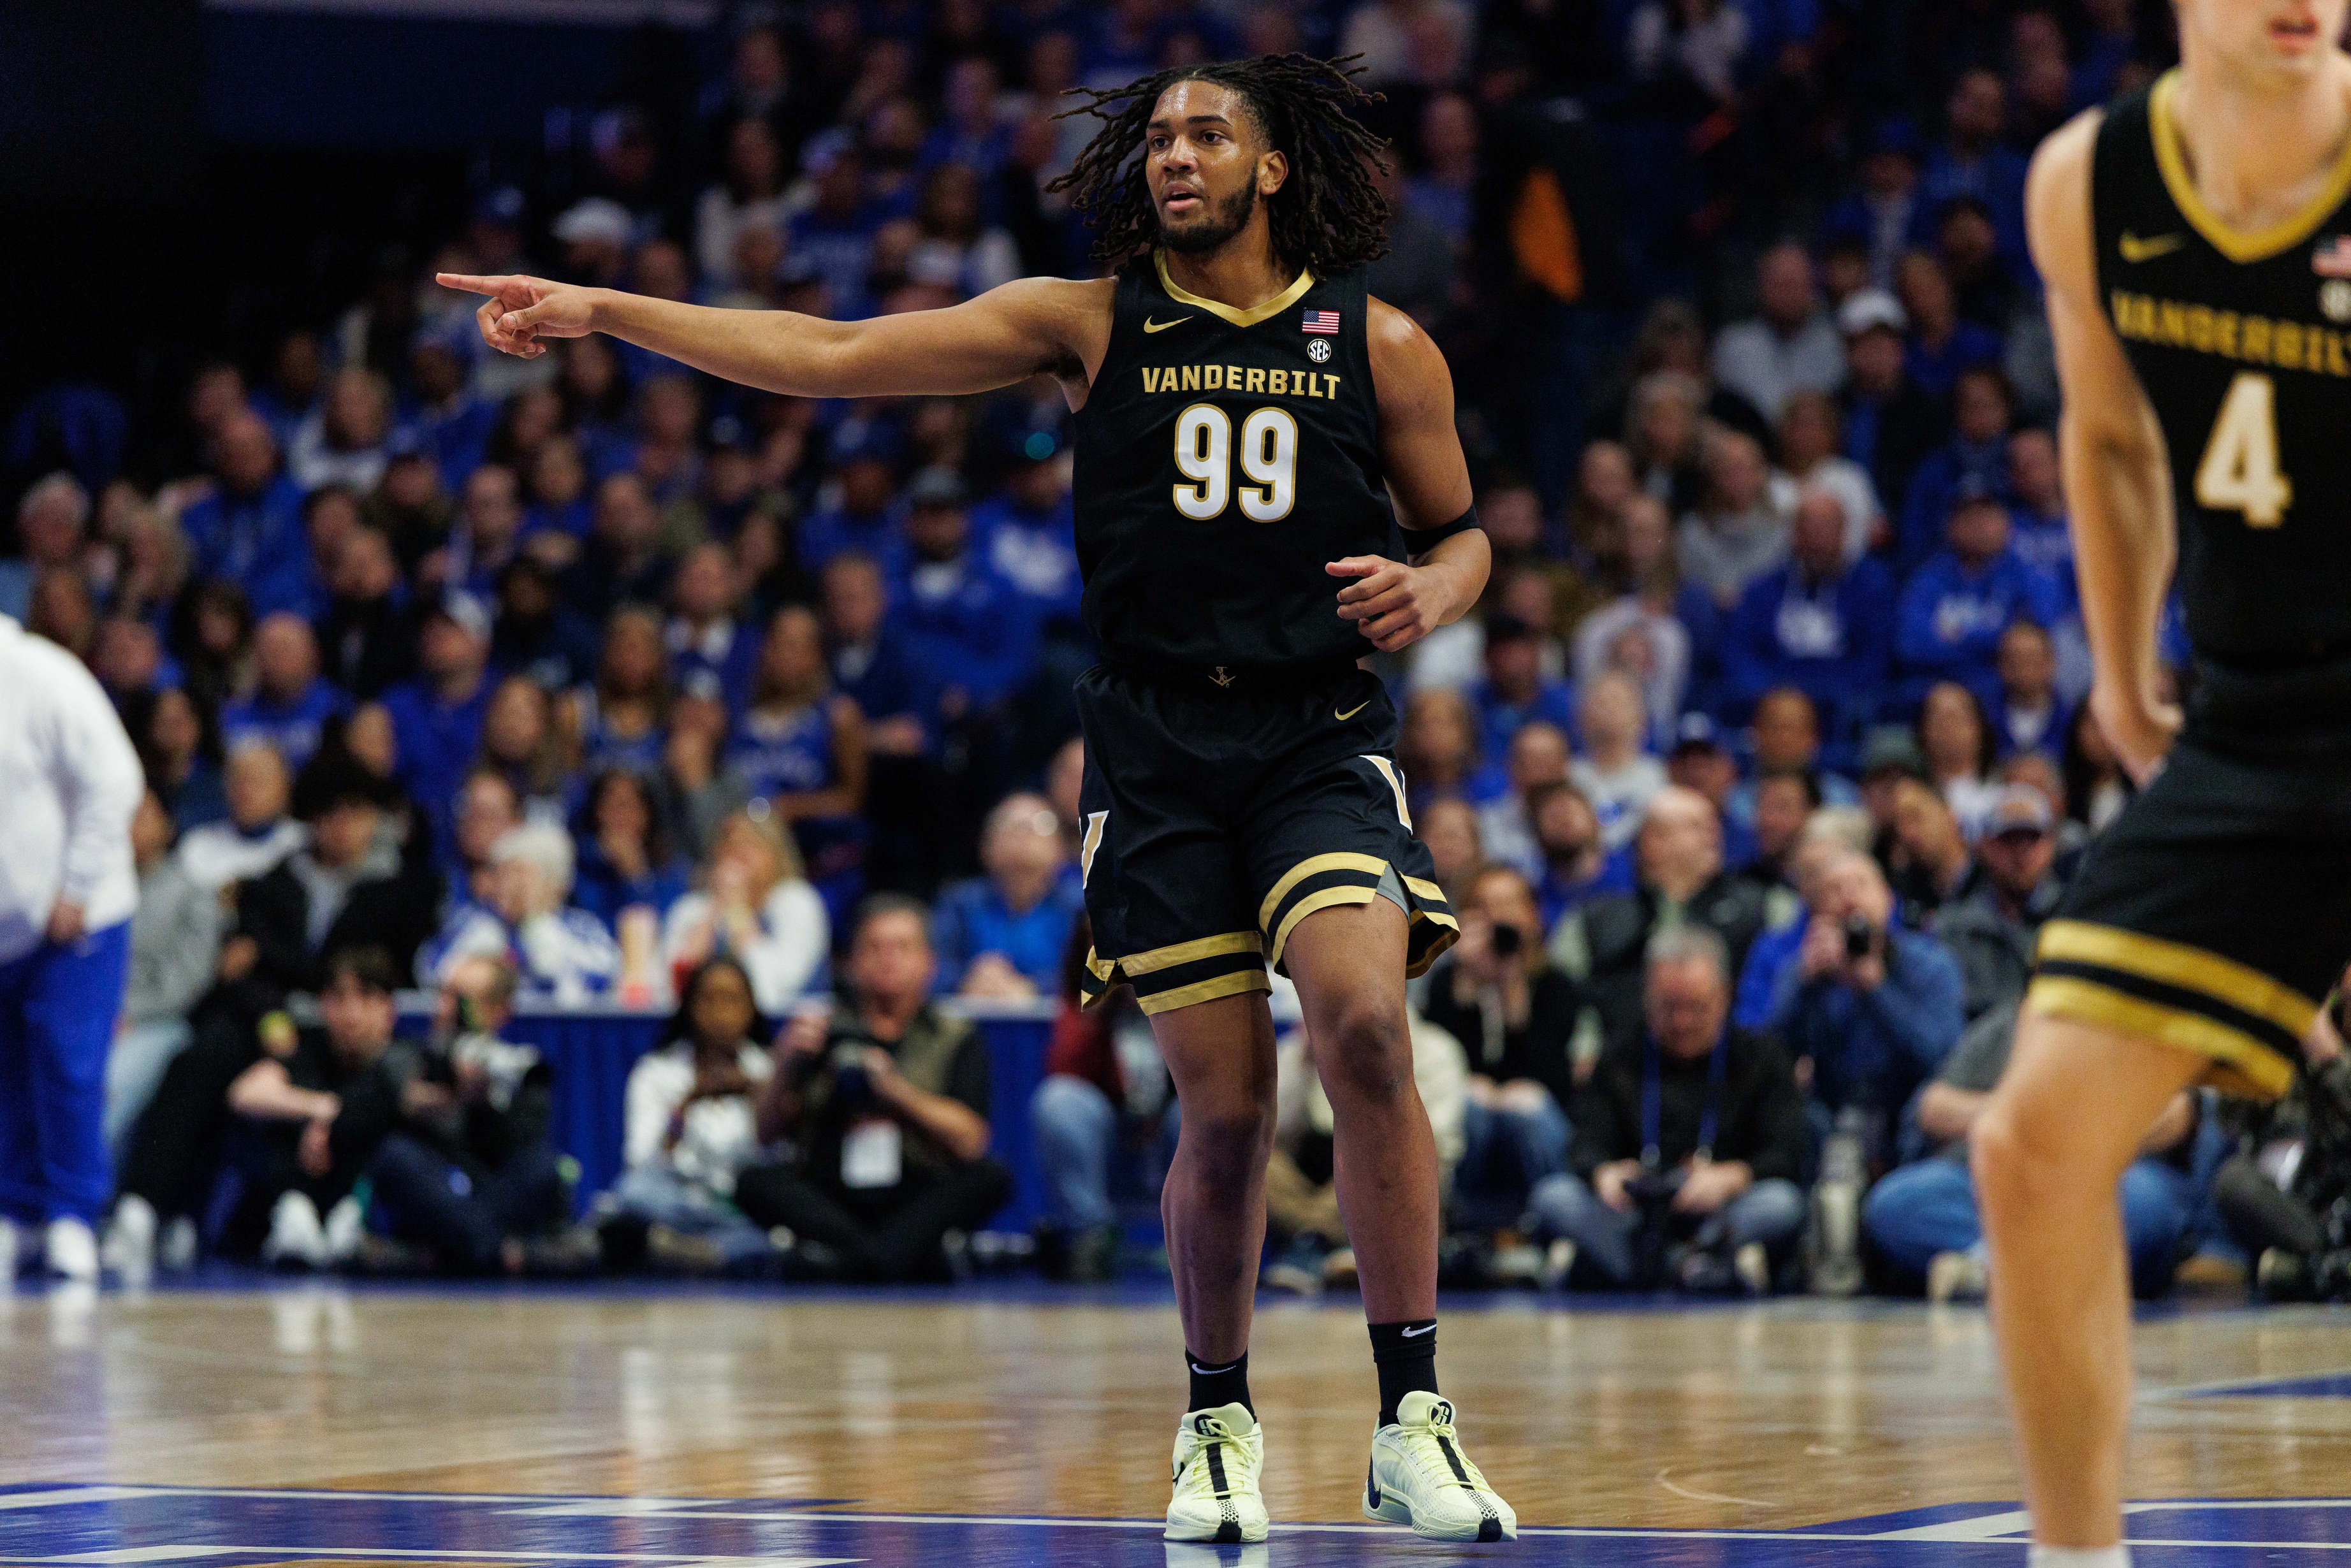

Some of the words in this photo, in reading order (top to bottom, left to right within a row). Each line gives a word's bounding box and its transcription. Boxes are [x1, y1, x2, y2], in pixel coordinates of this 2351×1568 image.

[1142, 365, 1341, 400] VANDERBILT
[1309, 340, 1330, 361] SEC
[1173, 403, 1298, 523] 99
[2195, 372, 2292, 528] 4
